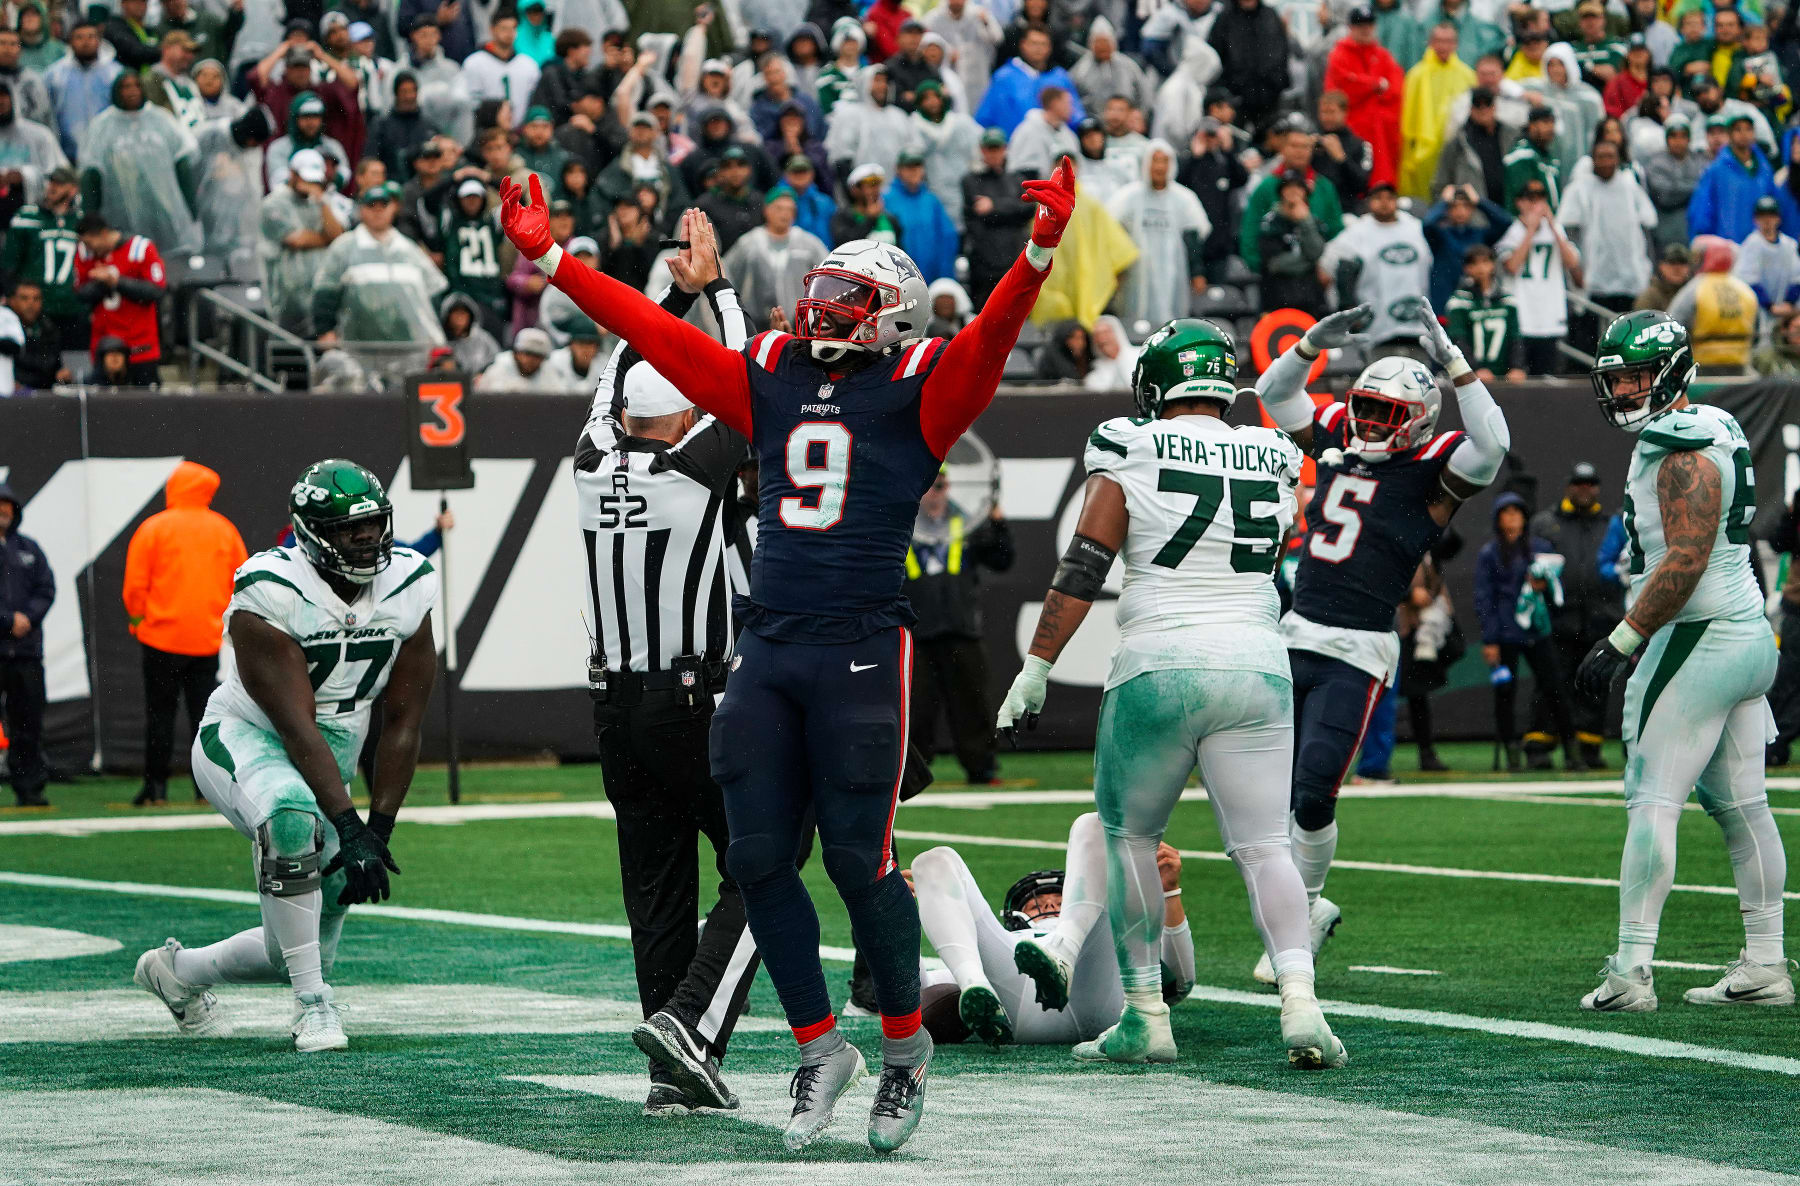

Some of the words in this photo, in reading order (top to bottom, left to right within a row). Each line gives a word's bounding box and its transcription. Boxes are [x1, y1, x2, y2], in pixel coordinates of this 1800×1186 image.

[44, 238, 77, 284] 17
[458, 225, 500, 276] 21
[1521, 244, 1553, 279] 17
[1473, 317, 1507, 361] 17
[1184, 385, 1211, 393] NEW
[1206, 361, 1220, 374] 75
[418, 382, 466, 447] 3
[800, 403, 841, 415] PATRIOTS
[778, 420, 854, 532] 9
[1152, 433, 1289, 479] VERA-TUCKER
[612, 474, 630, 494] R
[599, 495, 648, 529] 52
[1150, 467, 1281, 575] 75
[1309, 472, 1380, 564] 5
[303, 629, 340, 642] NEW
[342, 626, 389, 639] YORK
[302, 638, 395, 715] 77
